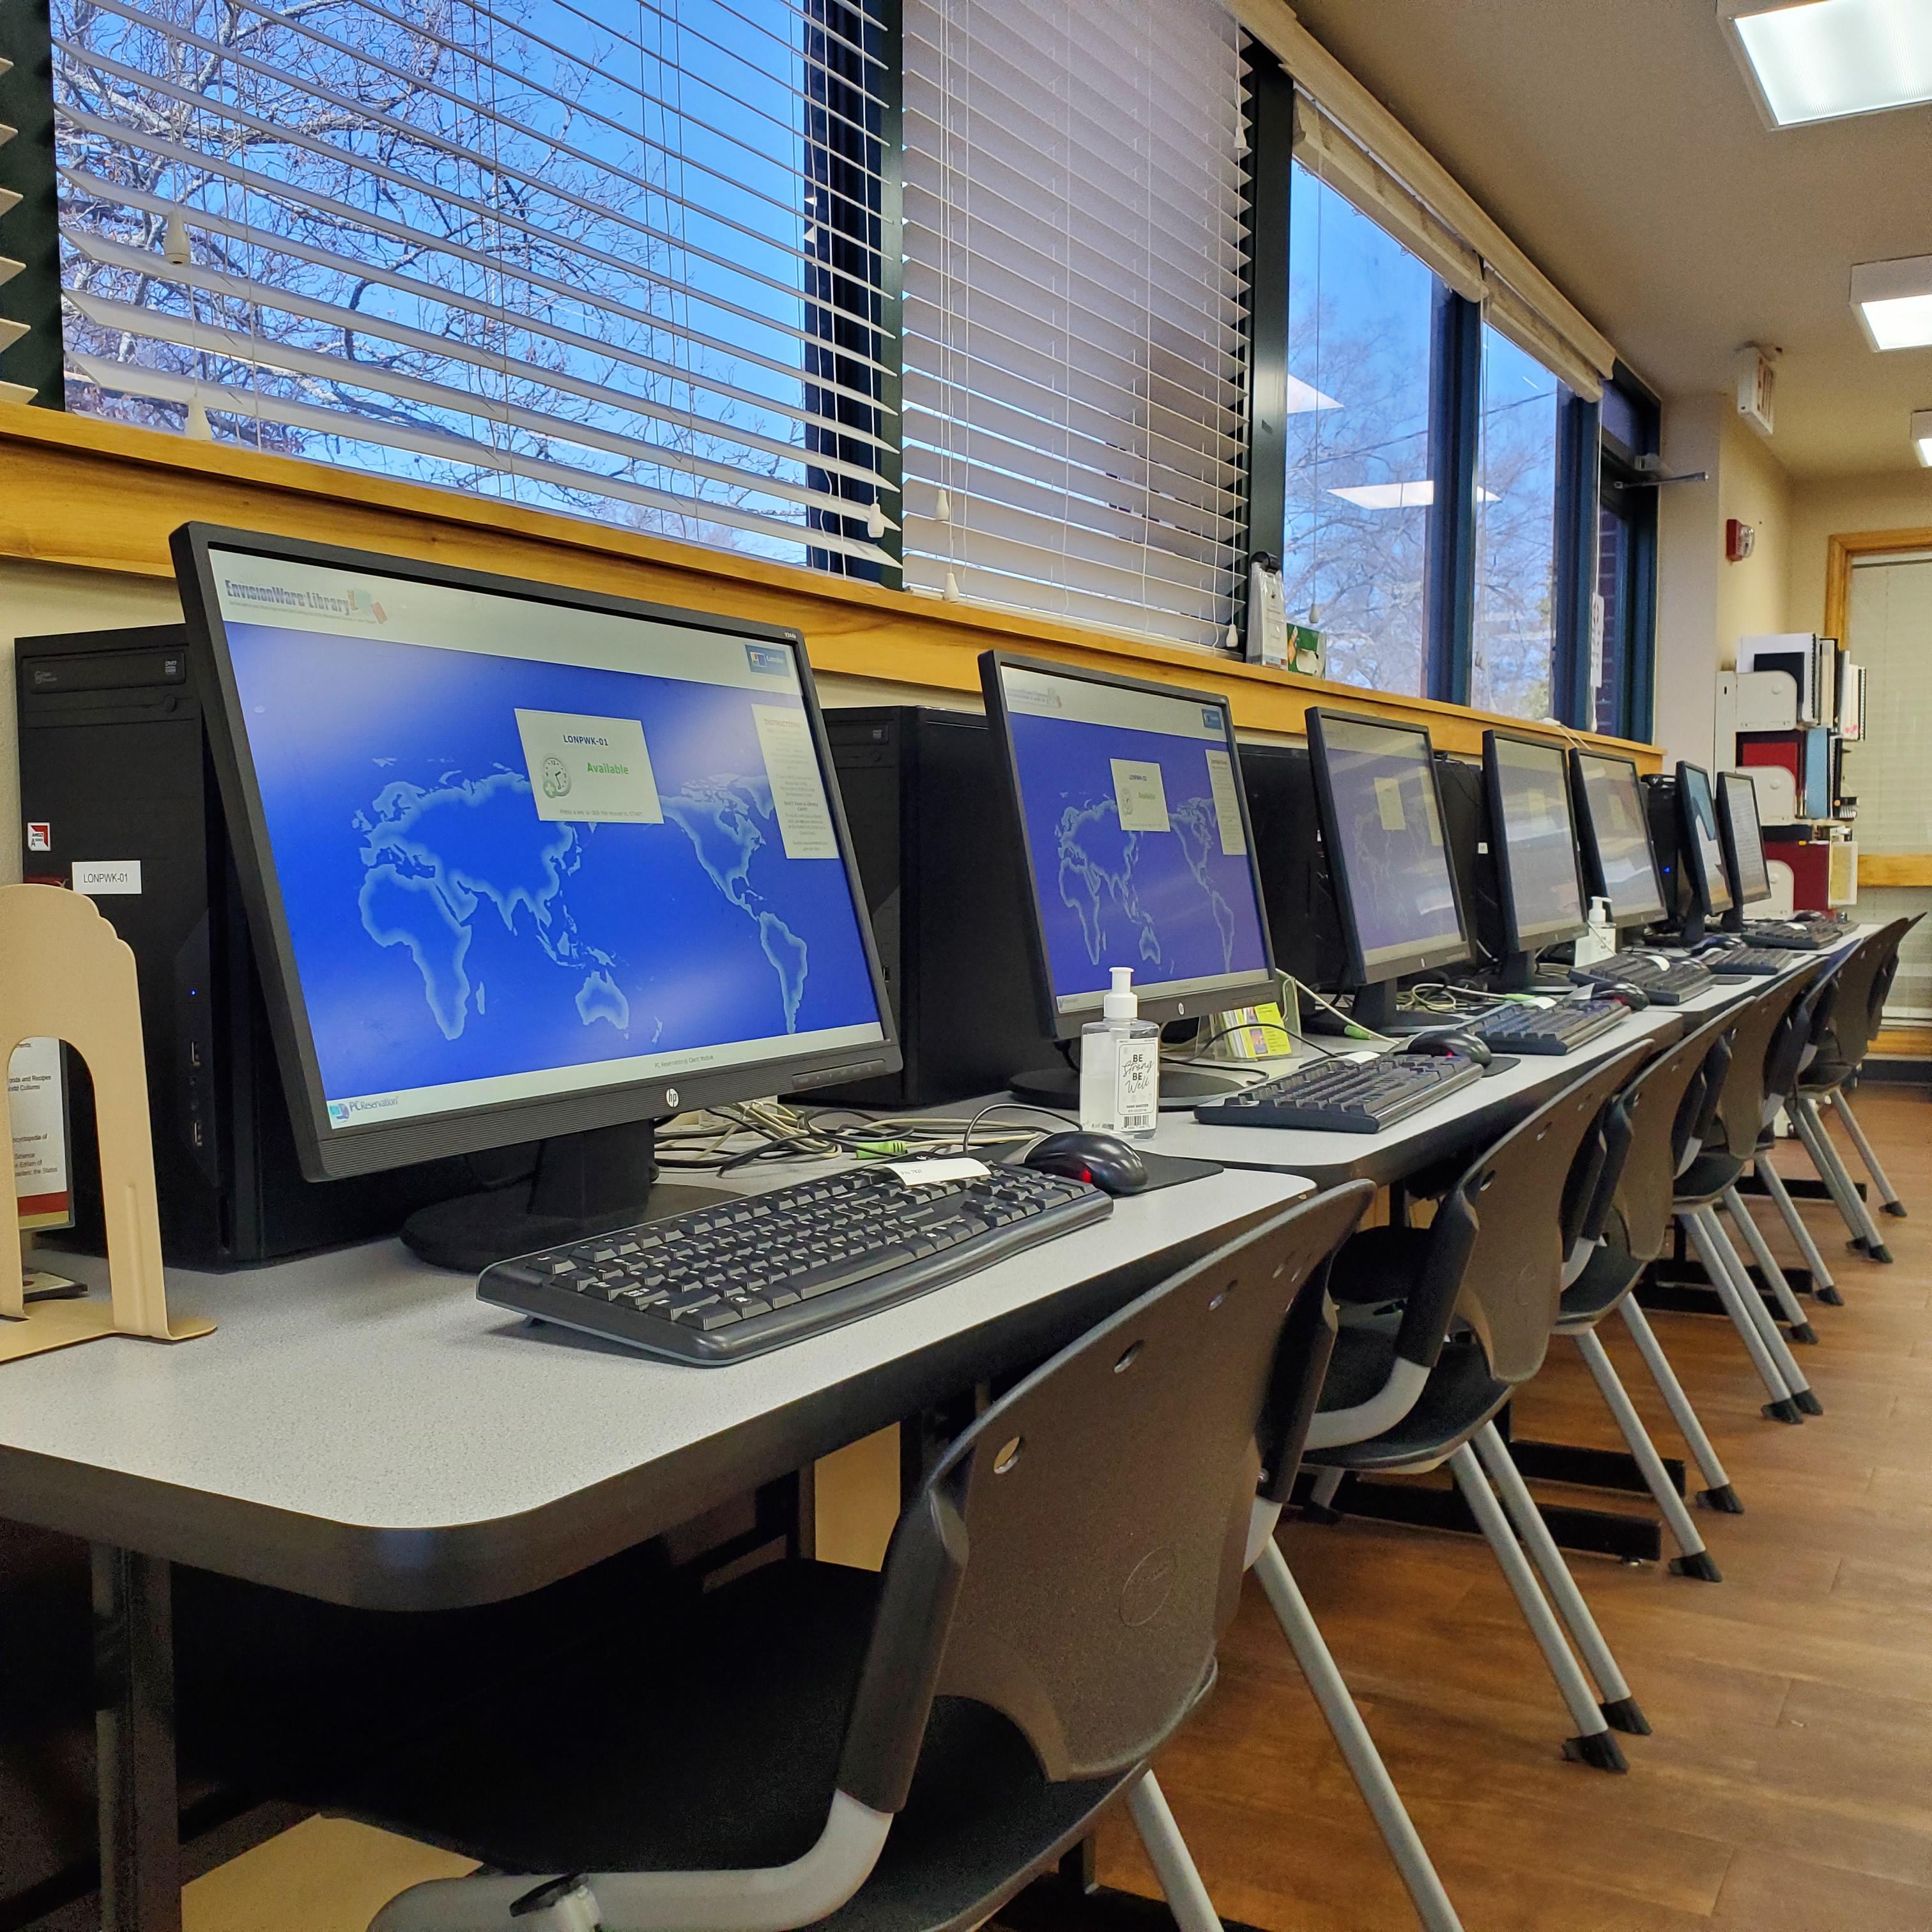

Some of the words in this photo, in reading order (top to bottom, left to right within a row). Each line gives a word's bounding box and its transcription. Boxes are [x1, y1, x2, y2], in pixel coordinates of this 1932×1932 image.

[306, 592, 349, 616] Library
[563, 735, 609, 746] LONPWK-01
[586, 762, 629, 774] Available
[83, 873, 128, 884] LONPWK-01
[1133, 1054, 1144, 1062] BE
[1122, 1061, 1154, 1078] Strong
[1132, 1072, 1143, 1081] BE
[1124, 1076, 1150, 1094] Well
